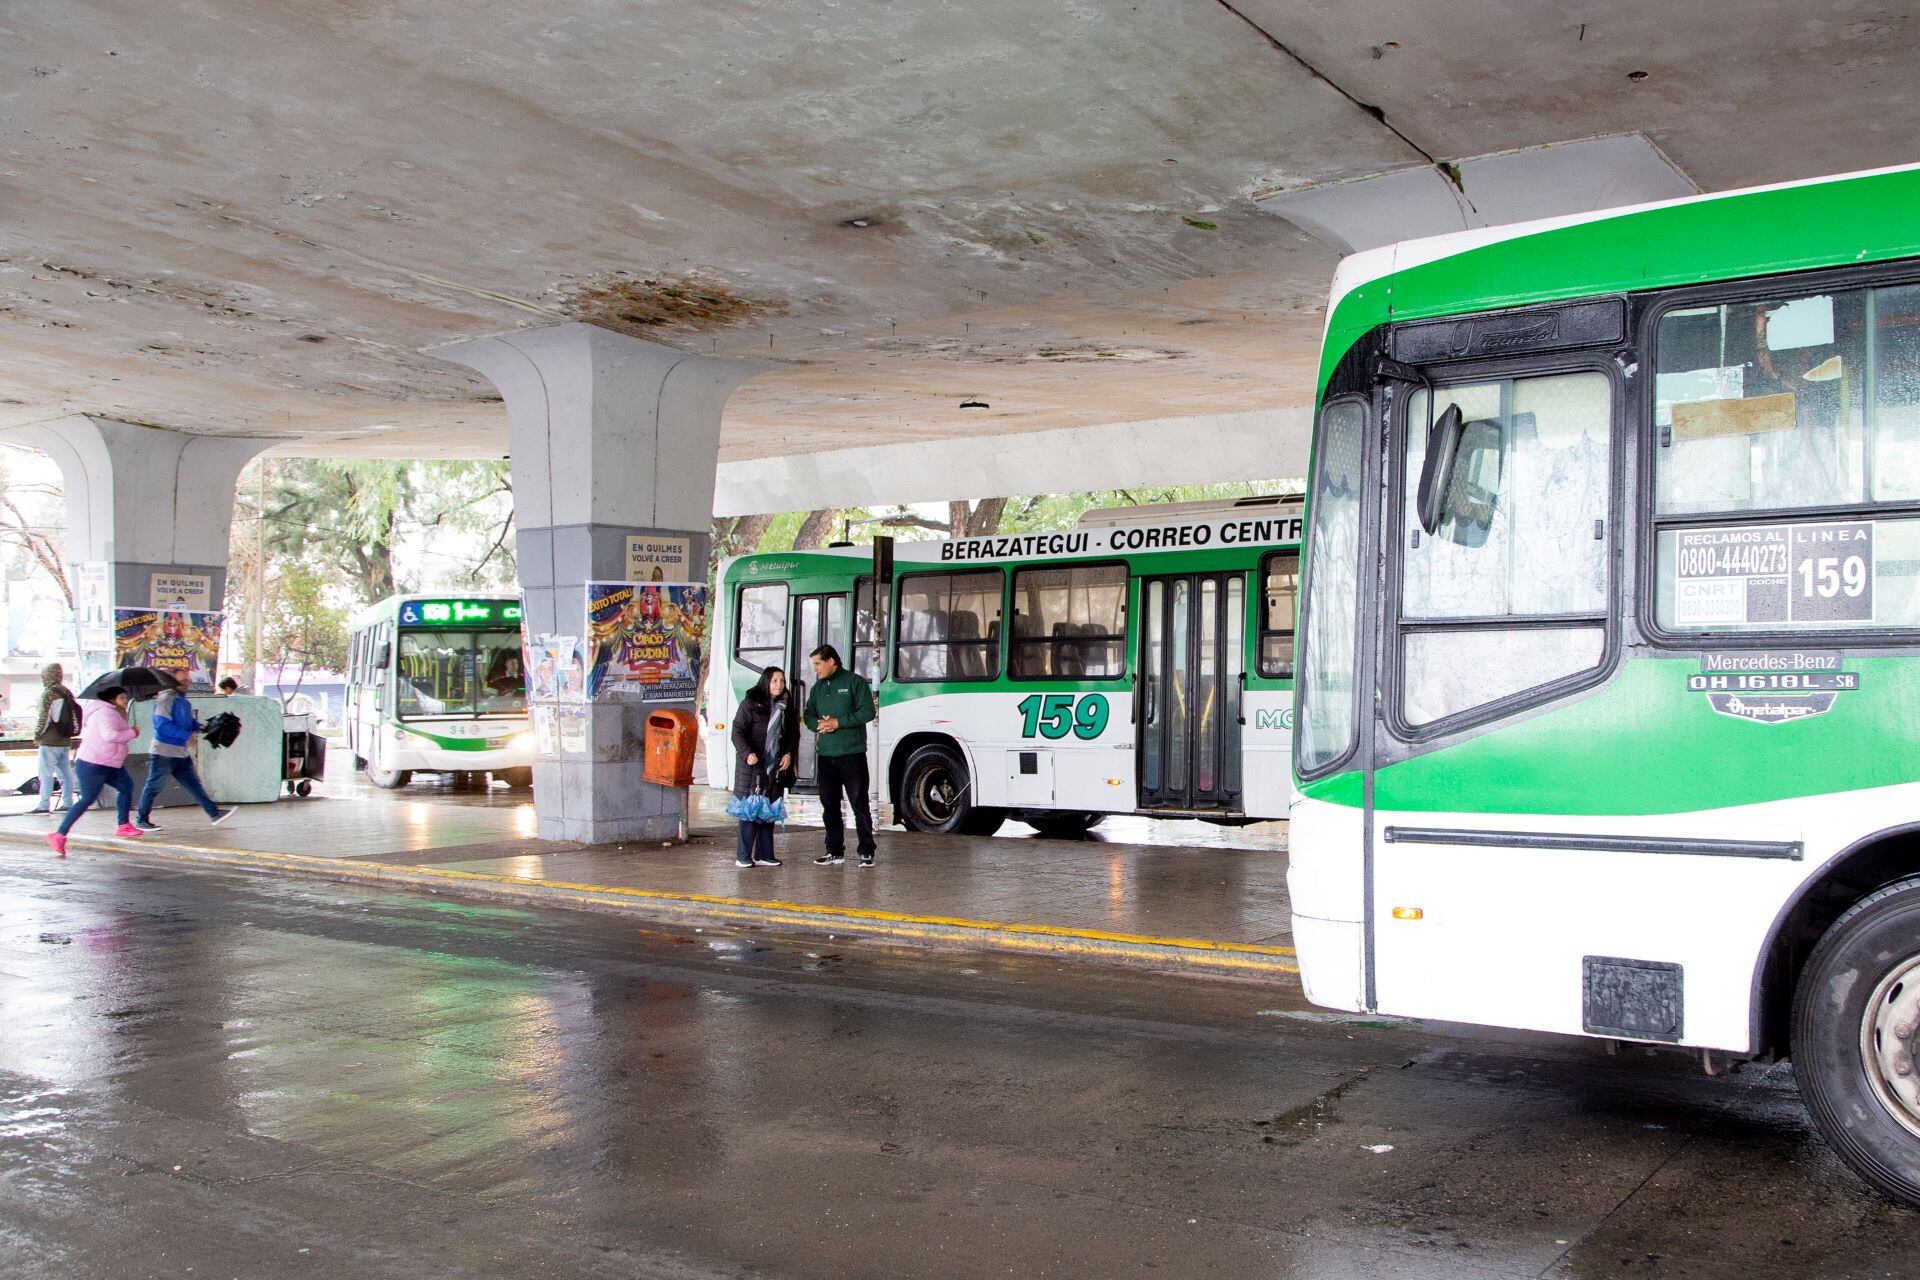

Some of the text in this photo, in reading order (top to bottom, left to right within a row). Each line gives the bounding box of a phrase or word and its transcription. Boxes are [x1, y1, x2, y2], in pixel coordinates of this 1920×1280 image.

[942, 532, 1089, 561] BERAZATEGUI
[1110, 524, 1211, 550] CORREO
[1684, 531, 1785, 546] RECLAMOS AL
[1797, 529, 1868, 543] LINEA
[632, 543, 683, 553] EN QUILMES
[661, 555, 682, 563] CREER
[1680, 543, 1787, 576] 0800-4440273
[170, 579, 205, 587] QUILMES
[1749, 578, 1787, 586] COCHE
[1798, 555, 1867, 598] 159
[1684, 583, 1739, 597] CNRT
[633, 633, 663, 645] CIRCO
[629, 646, 669, 659] HOUDINI
[1706, 653, 1836, 670] Mercedes-Benz
[1690, 675, 1728, 689] OH
[1017, 693, 1110, 740] 159
